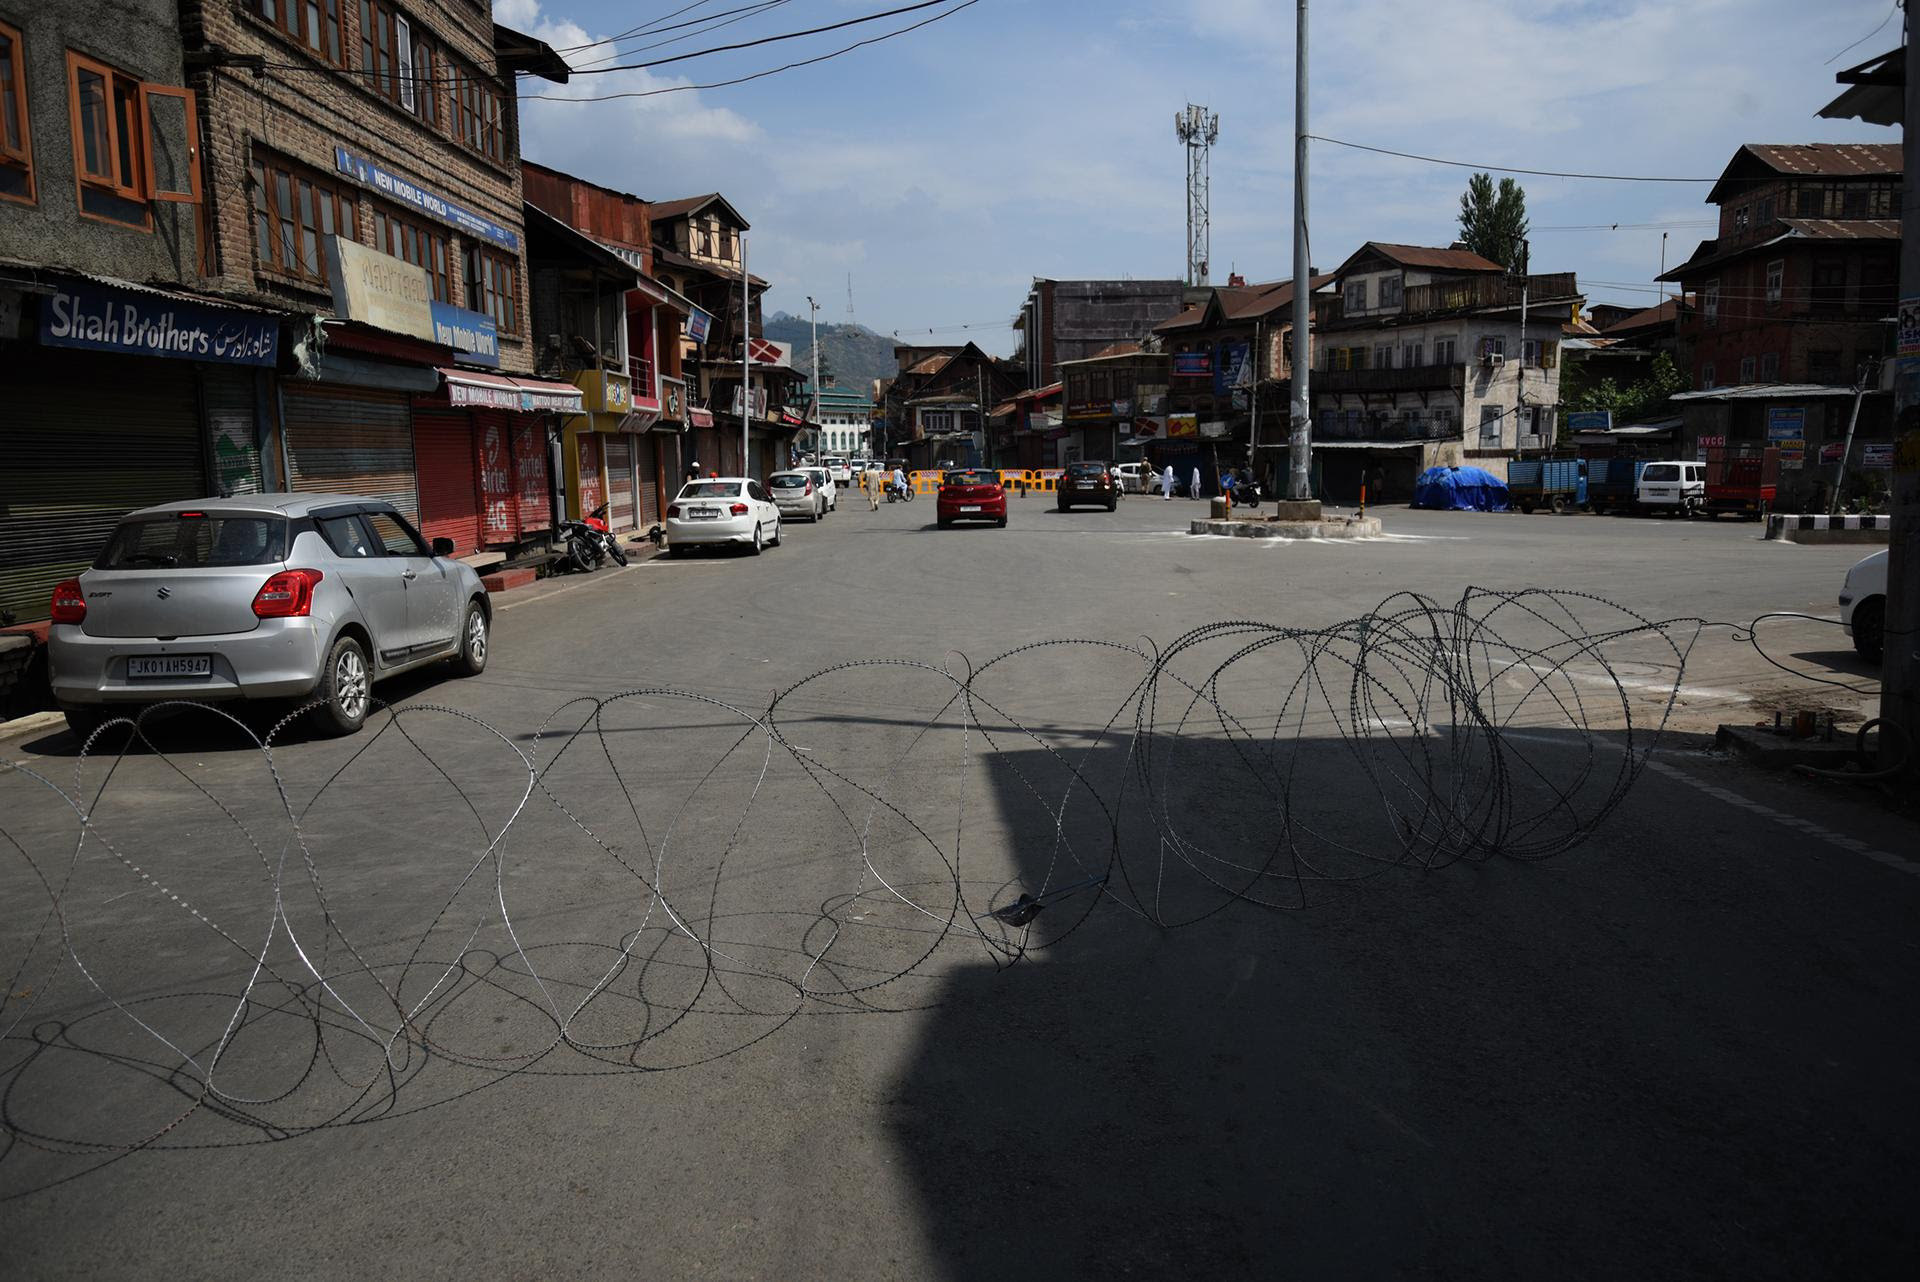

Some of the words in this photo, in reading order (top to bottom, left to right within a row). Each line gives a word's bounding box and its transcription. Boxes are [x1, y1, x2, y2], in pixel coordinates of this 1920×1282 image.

[374, 168, 393, 192] NEW
[393, 180, 422, 204] MOBILE
[422, 193, 447, 218] WORLD
[51, 292, 118, 344] Shah
[123, 304, 209, 354] Brothers
[451, 384, 467, 402] NEW
[482, 464, 510, 493] airtel
[519, 453, 544, 482] airtel
[487, 500, 509, 532] 4G
[582, 490, 595, 514] 4G
[137, 659, 208, 674] JK01AH5947
